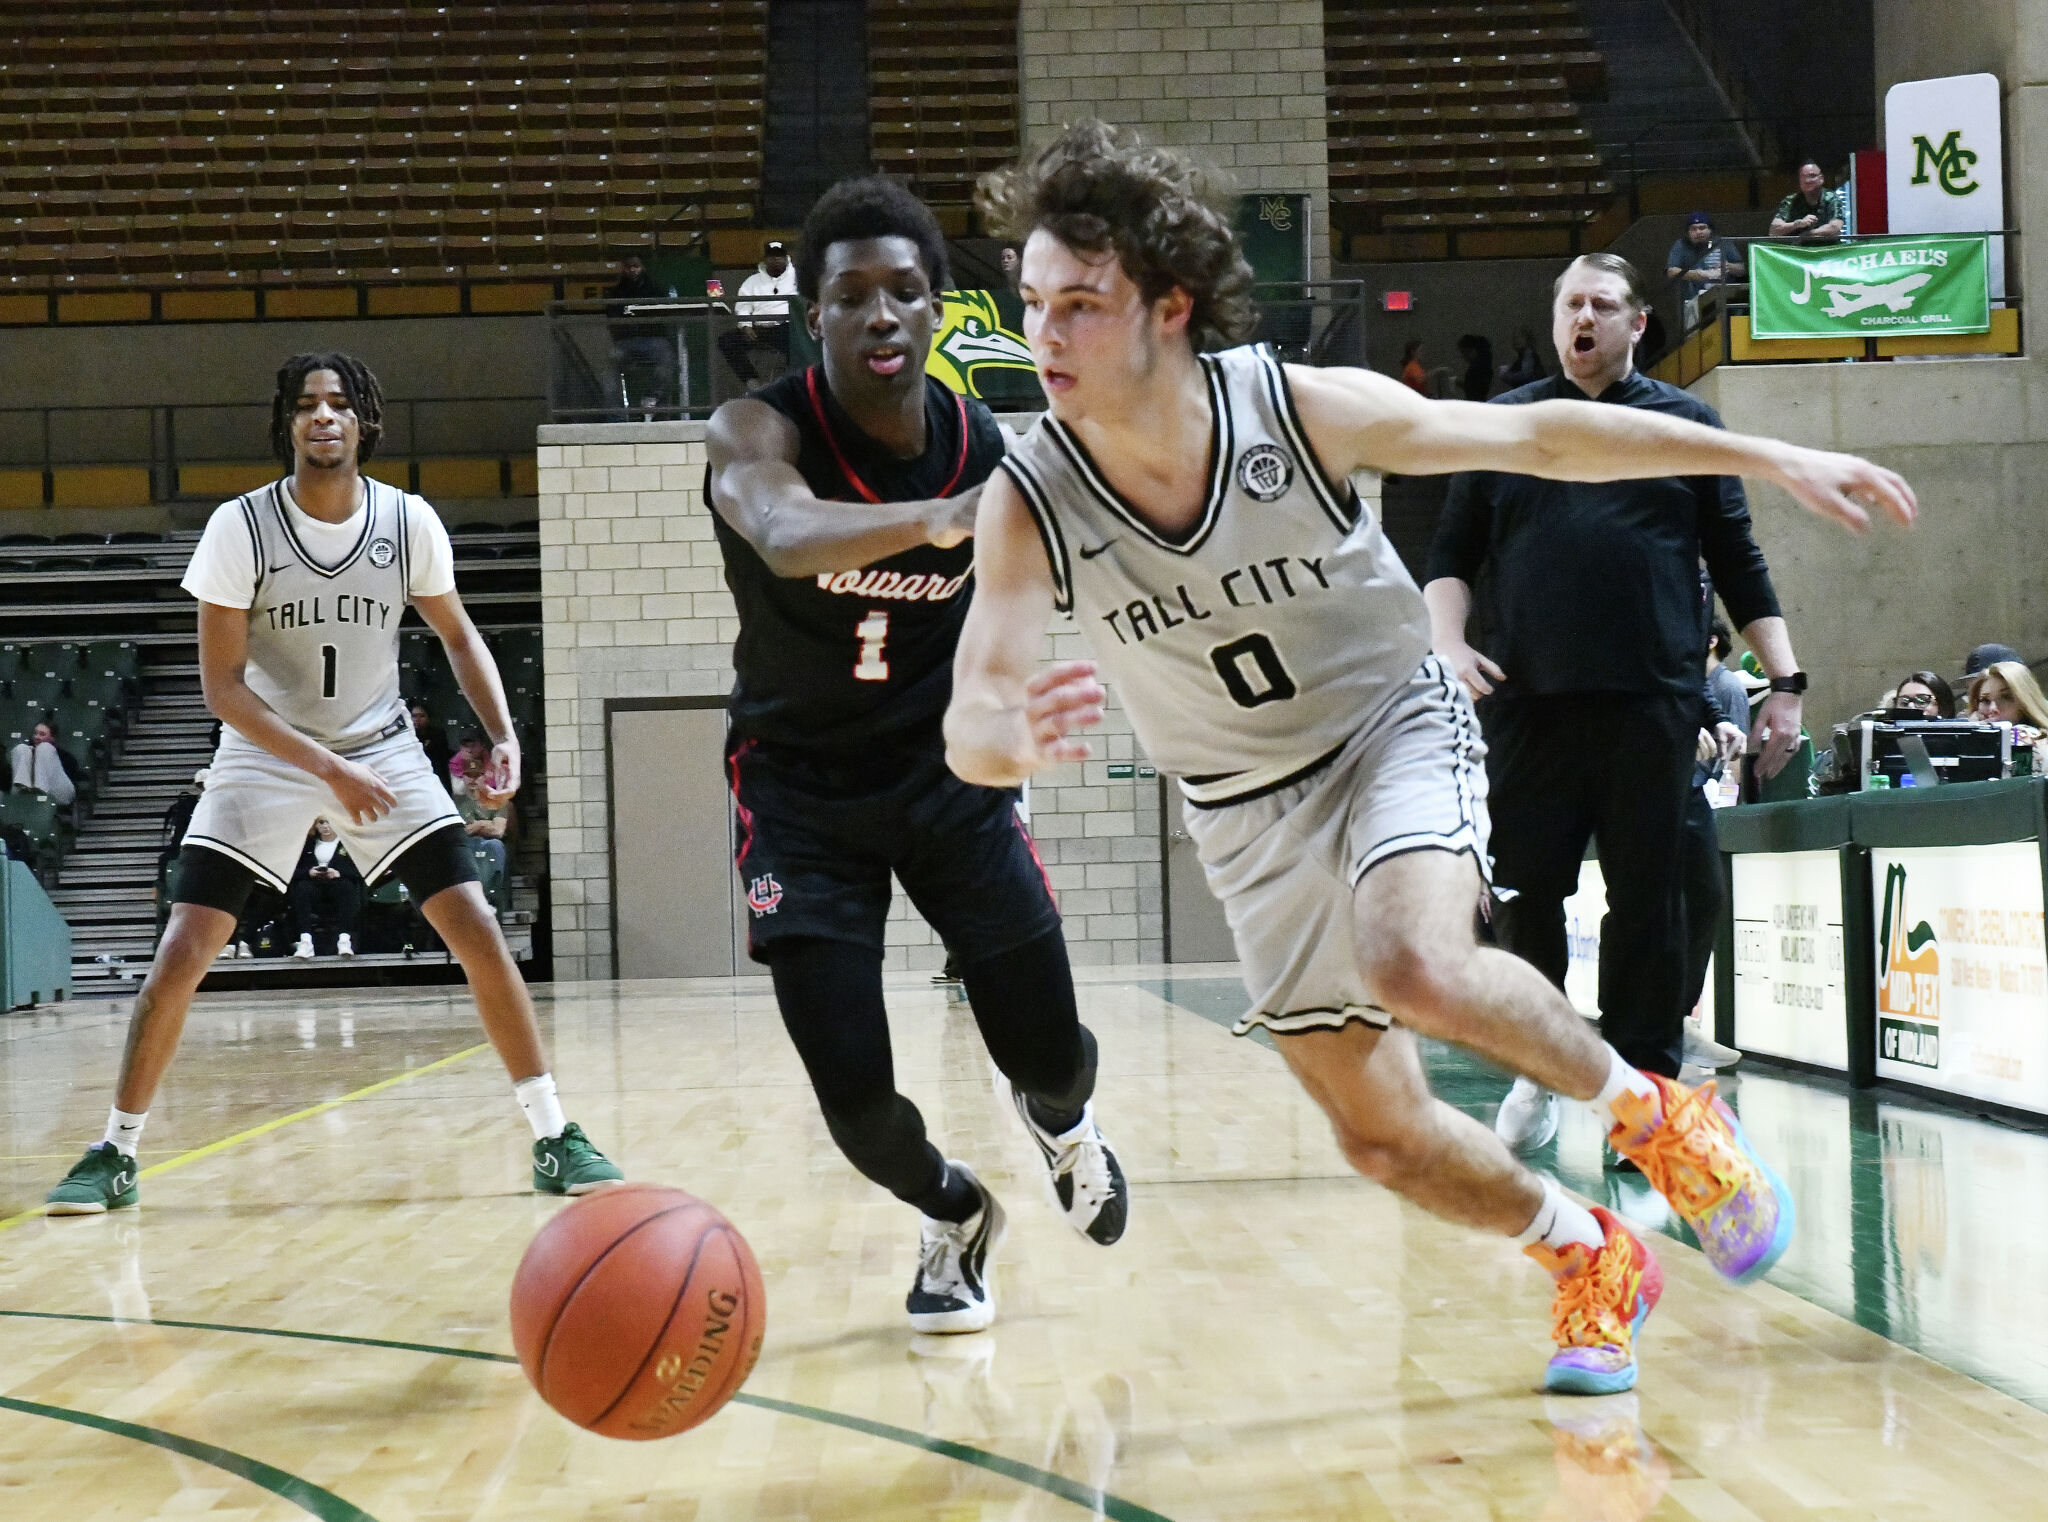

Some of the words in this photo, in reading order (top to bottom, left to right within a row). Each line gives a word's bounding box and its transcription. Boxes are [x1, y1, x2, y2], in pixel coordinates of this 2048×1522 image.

[1860, 315, 1918, 326] CHARCOAL
[1920, 313, 1952, 323] GRILL
[817, 561, 974, 601] oward
[1102, 584, 1212, 645] TALL
[1220, 556, 1330, 608] CITY
[267, 597, 326, 630] TALL
[337, 594, 390, 630] CITY
[321, 644, 338, 698] 1
[854, 610, 890, 682] 1
[1210, 631, 1297, 709] 0
